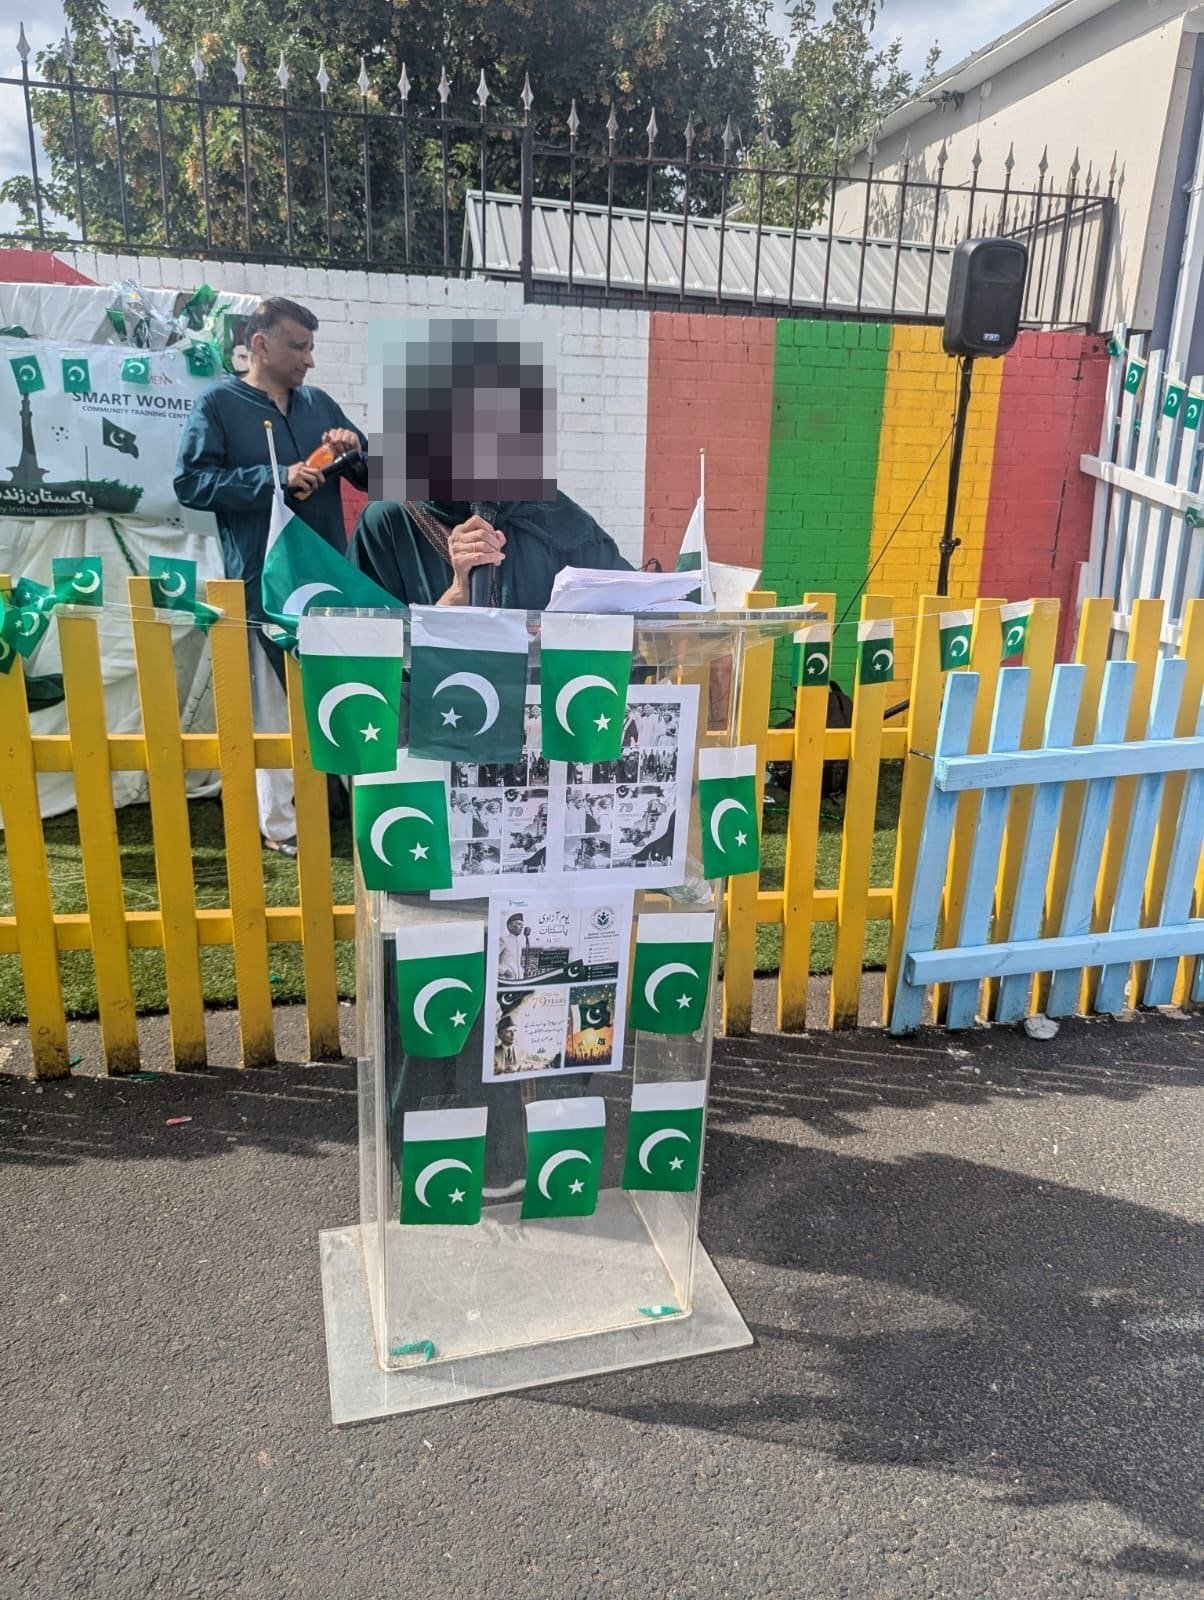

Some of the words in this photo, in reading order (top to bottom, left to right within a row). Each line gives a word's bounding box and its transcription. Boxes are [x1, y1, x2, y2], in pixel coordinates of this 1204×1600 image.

[72, 391, 131, 406] SMART
[136, 395, 195, 411] WOME
[82, 405, 129, 414] COMMUNITY
[131, 409, 167, 418] TRAINING
[27, 487, 95, 509] پاکستان
